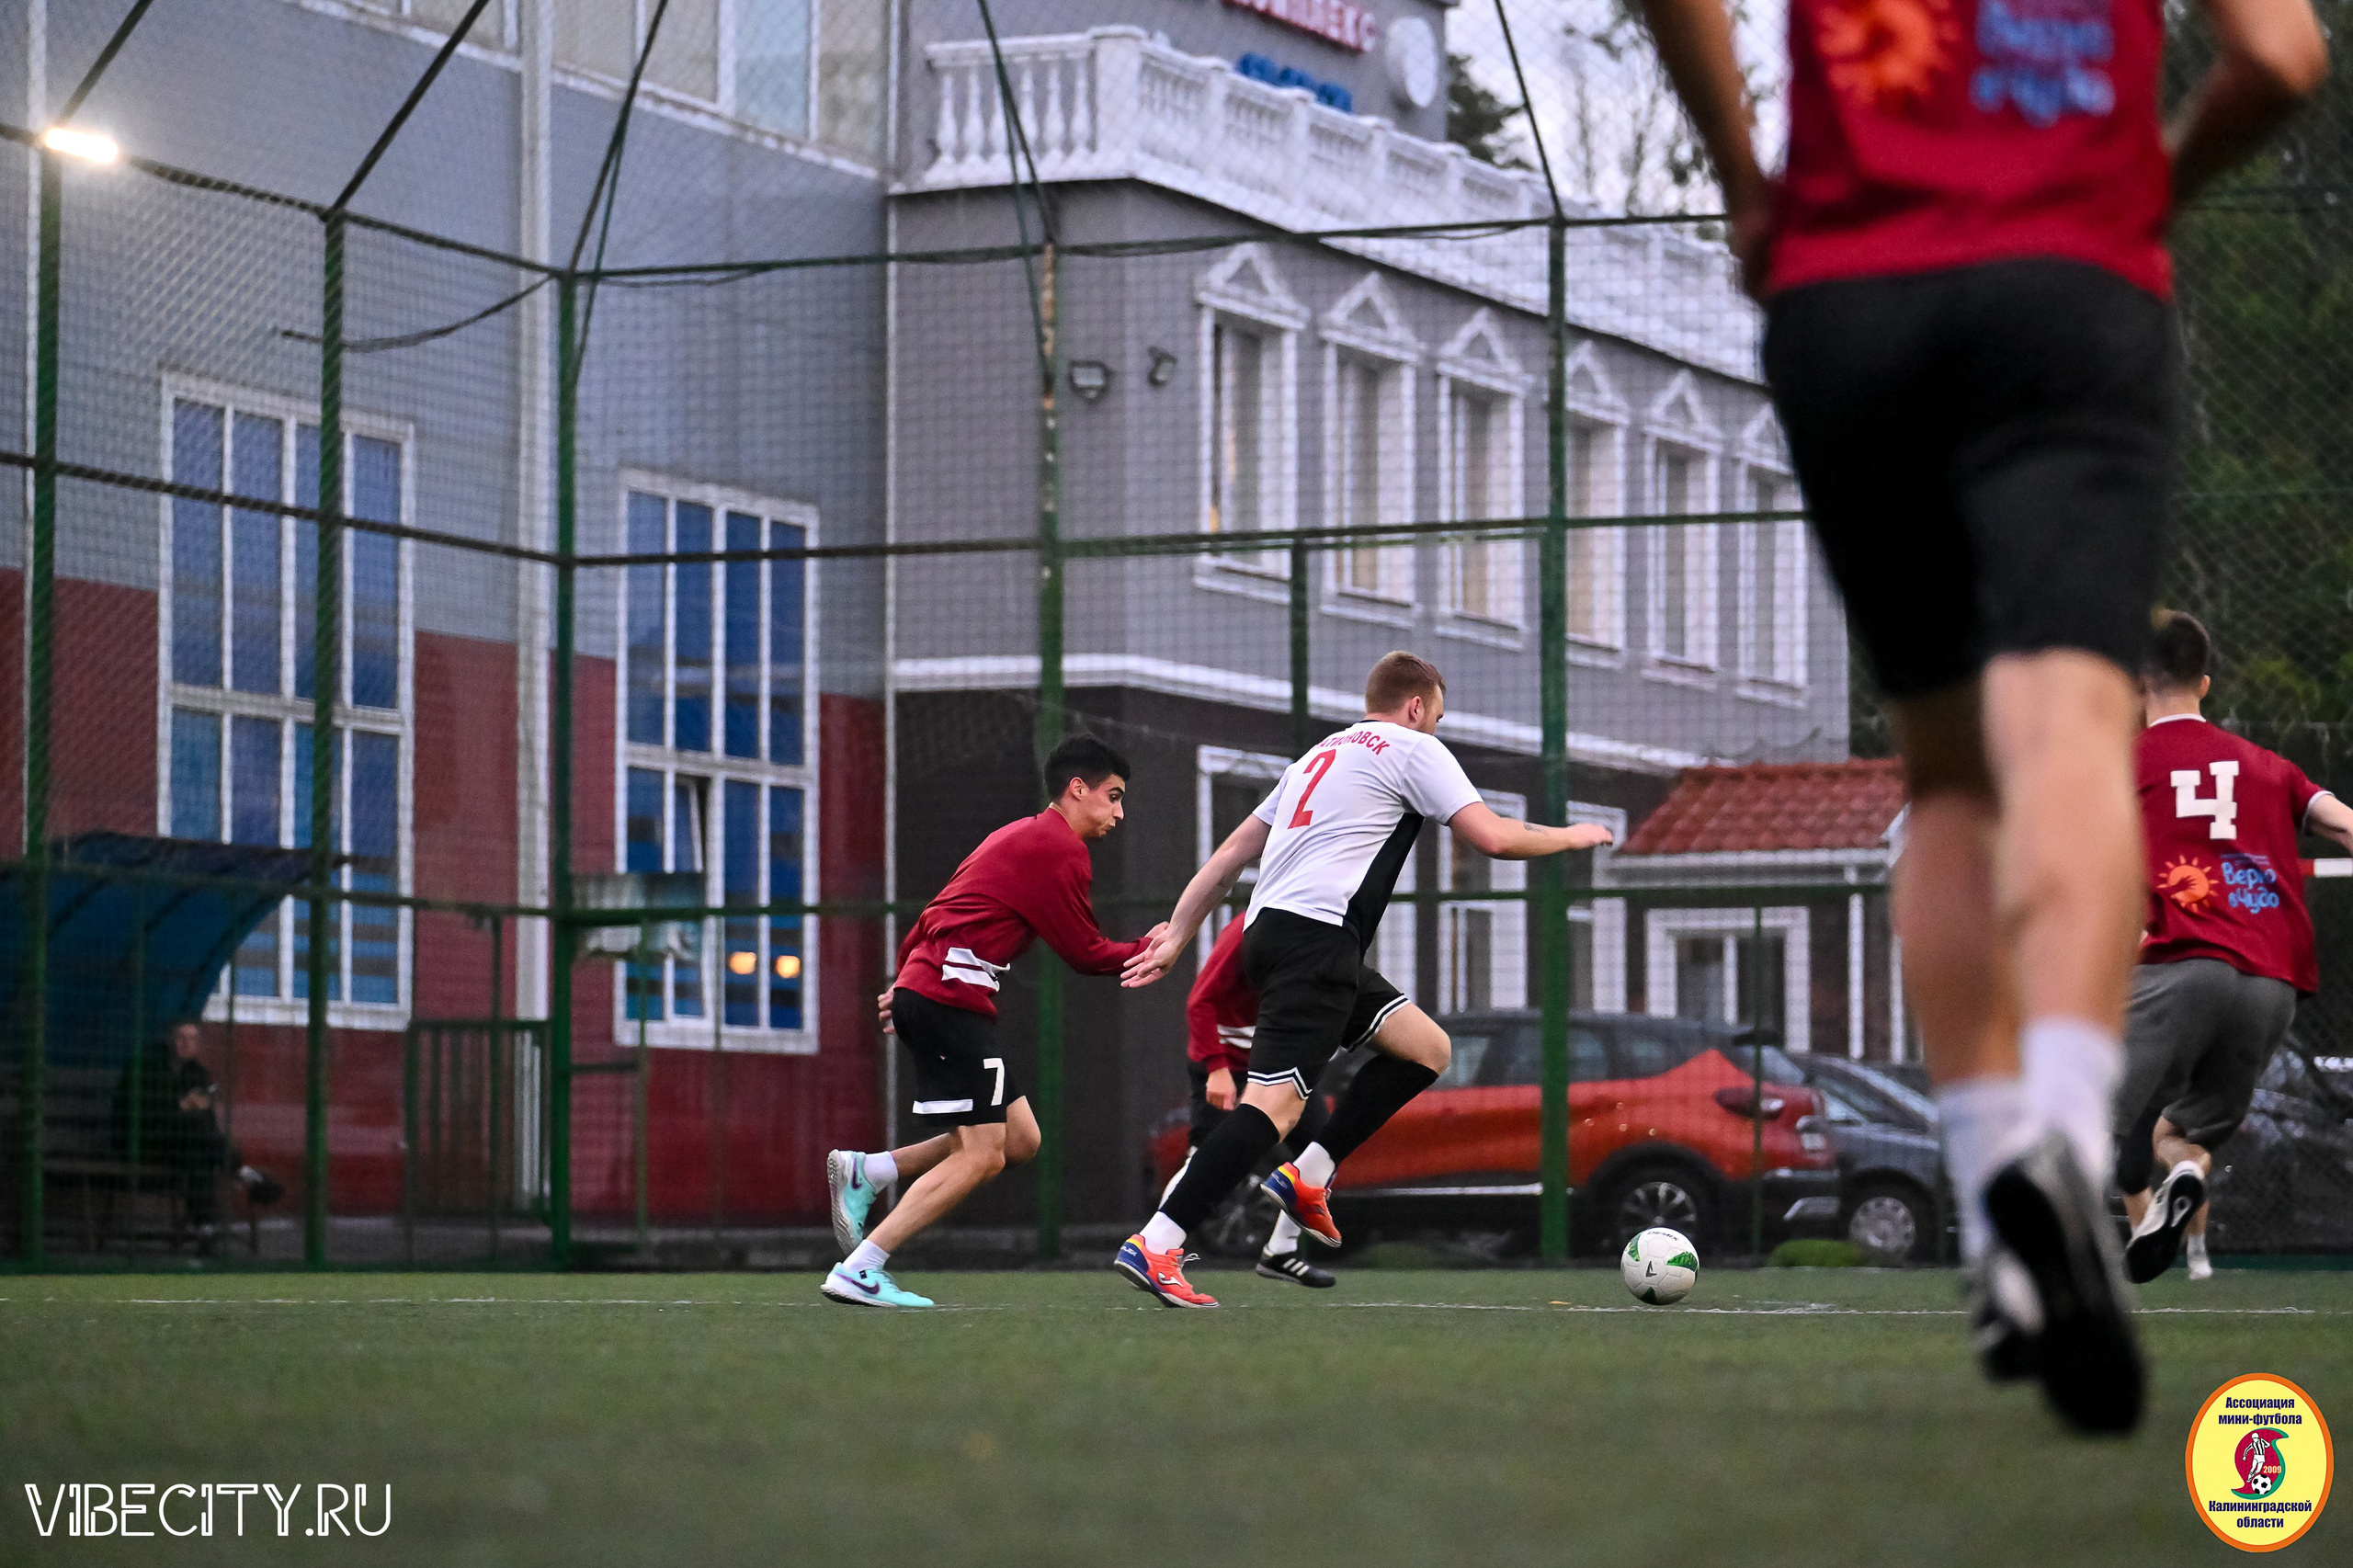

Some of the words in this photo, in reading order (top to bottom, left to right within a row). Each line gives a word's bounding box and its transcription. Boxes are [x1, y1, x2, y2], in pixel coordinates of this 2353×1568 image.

[1287, 748, 1336, 830] 2
[2170, 760, 2240, 840] 4
[983, 1057, 1006, 1107] 7
